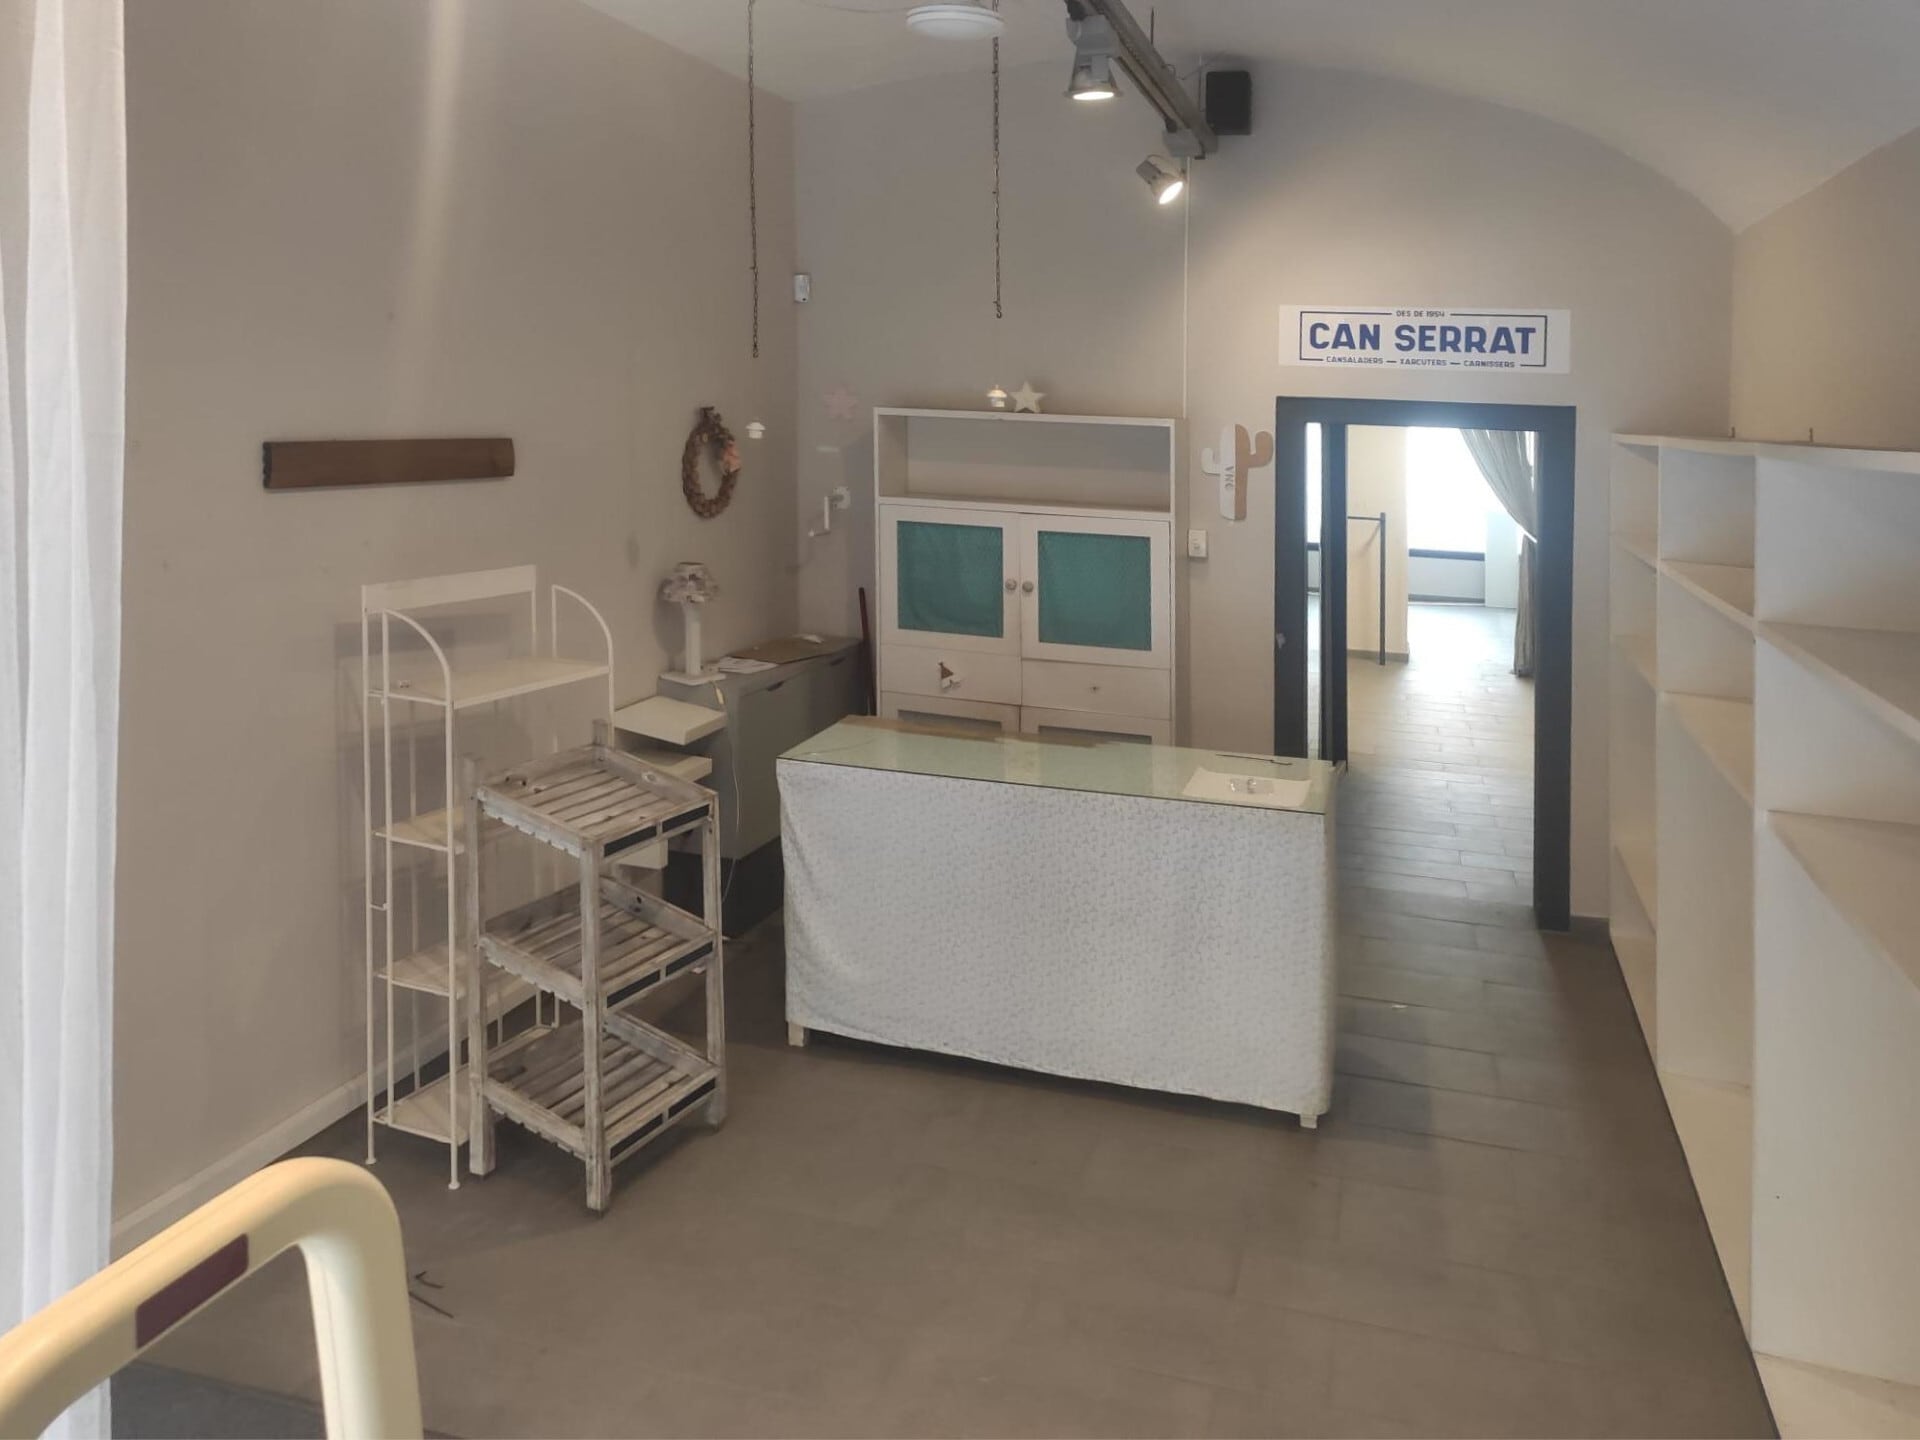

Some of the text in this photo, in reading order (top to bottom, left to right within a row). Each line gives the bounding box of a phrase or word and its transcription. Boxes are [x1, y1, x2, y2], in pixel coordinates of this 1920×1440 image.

[1309, 322, 1536, 354] CAN SERRAT
[1326, 356, 1384, 364] CANSALADERS
[1464, 360, 1515, 368] CARNISSERS
